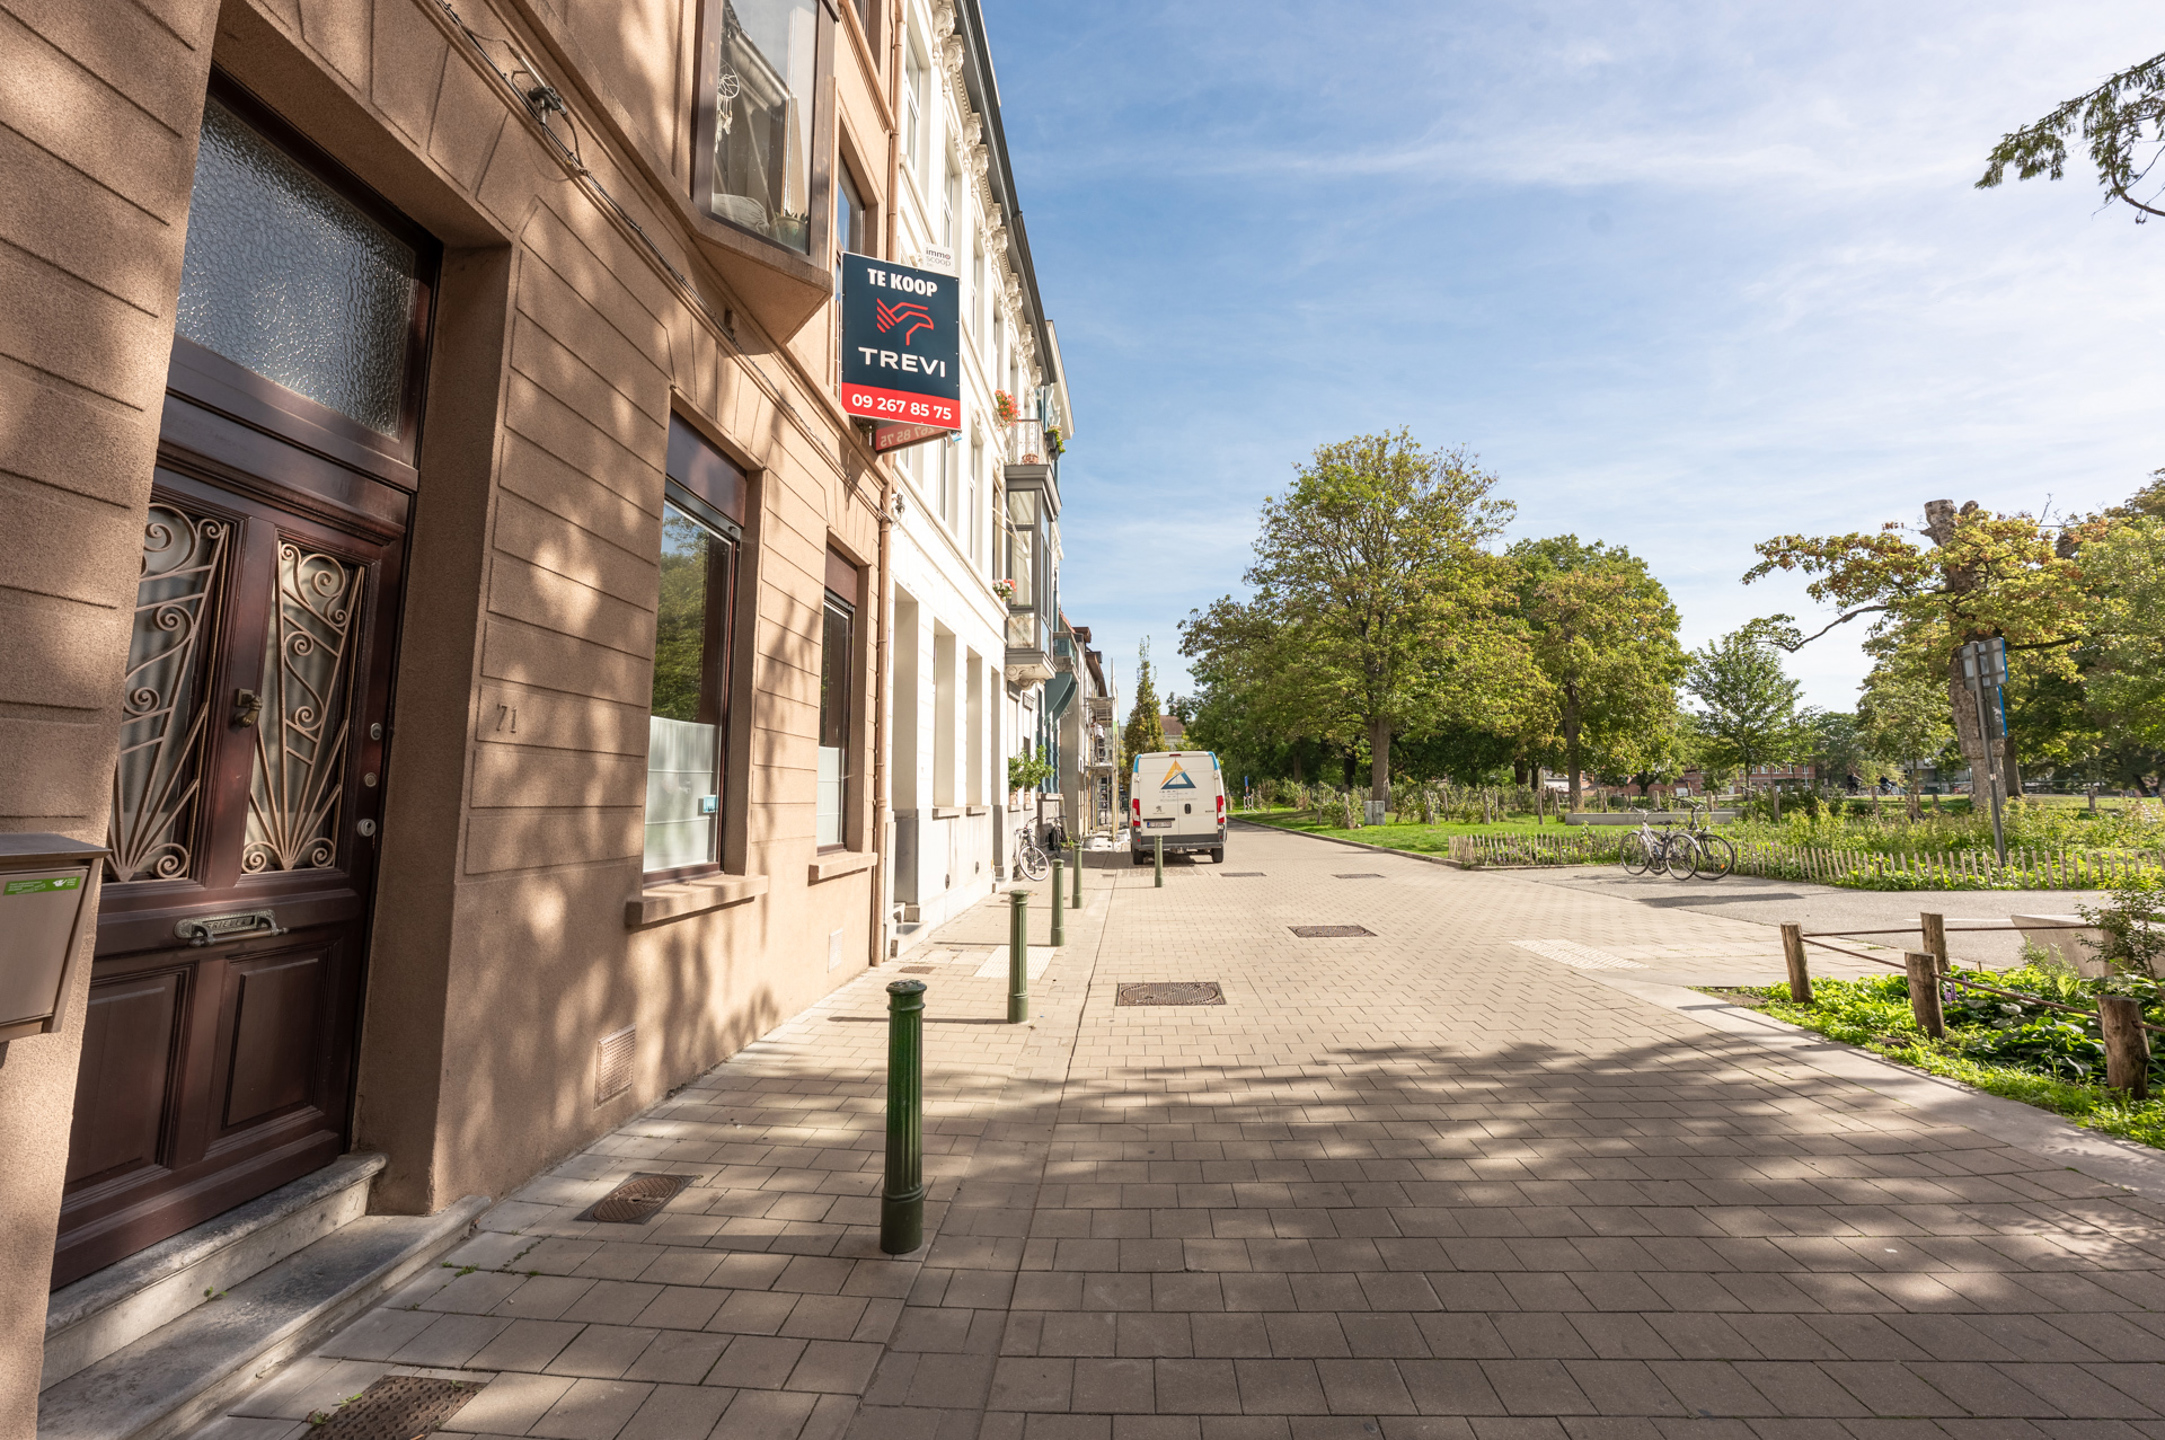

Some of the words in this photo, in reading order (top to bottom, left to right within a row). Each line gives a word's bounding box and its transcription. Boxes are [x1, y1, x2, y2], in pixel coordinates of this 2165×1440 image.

[926, 247, 951, 260] immo
[926, 255, 951, 267] scoop
[867, 268, 886, 287] TE
[890, 273, 938, 297] KOOP
[858, 346, 946, 378] TREVI
[852, 393, 873, 409] 09
[877, 397, 906, 414] 267
[910, 402, 930, 417] 85
[933, 405, 952, 420] 75
[497, 703, 517, 734] 71
